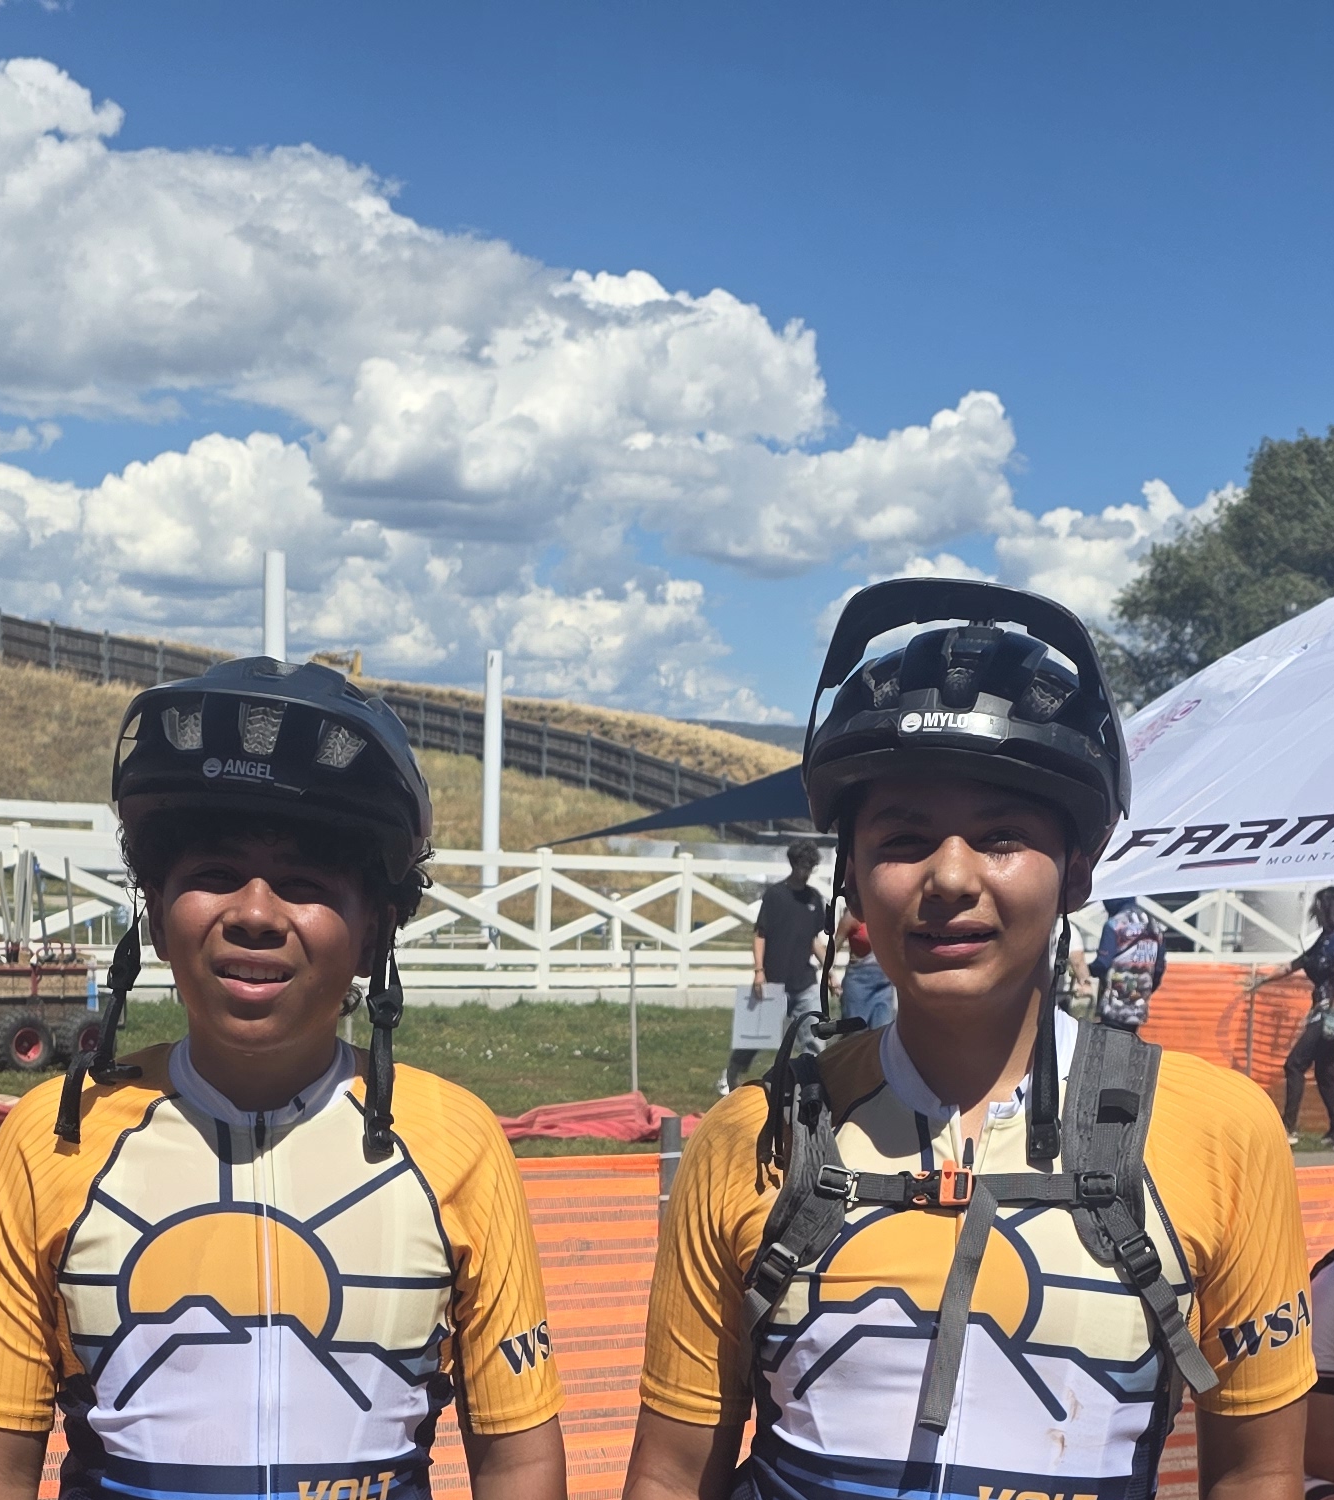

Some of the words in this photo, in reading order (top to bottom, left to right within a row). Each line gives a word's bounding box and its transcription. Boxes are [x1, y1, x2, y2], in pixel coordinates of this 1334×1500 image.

[223, 759, 274, 780] ANGEL
[499, 1320, 552, 1375] WS
[1219, 1290, 1311, 1361] WSA
